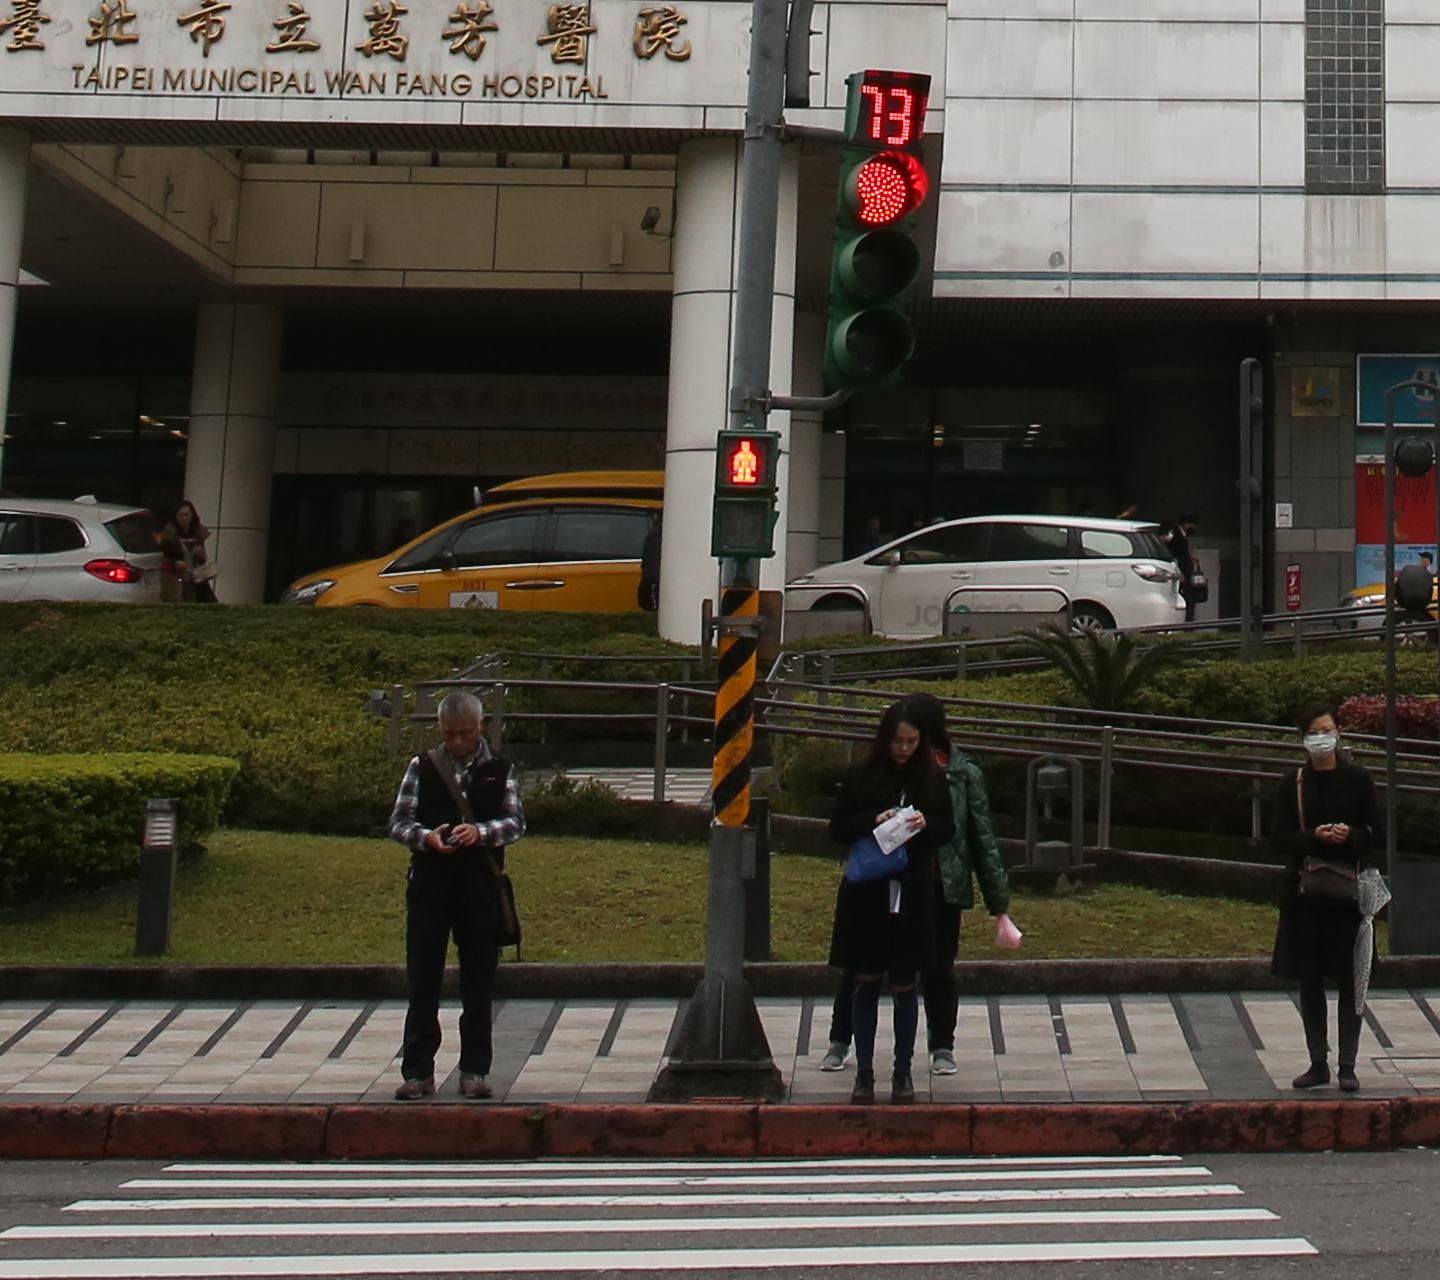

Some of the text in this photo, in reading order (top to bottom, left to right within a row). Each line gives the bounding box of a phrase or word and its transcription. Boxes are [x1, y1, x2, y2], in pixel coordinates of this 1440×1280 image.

[71, 63, 609, 100] TAIPEI MUNICIPAL WAN FANG HOSPITAL
[861, 85, 913, 145] 73
